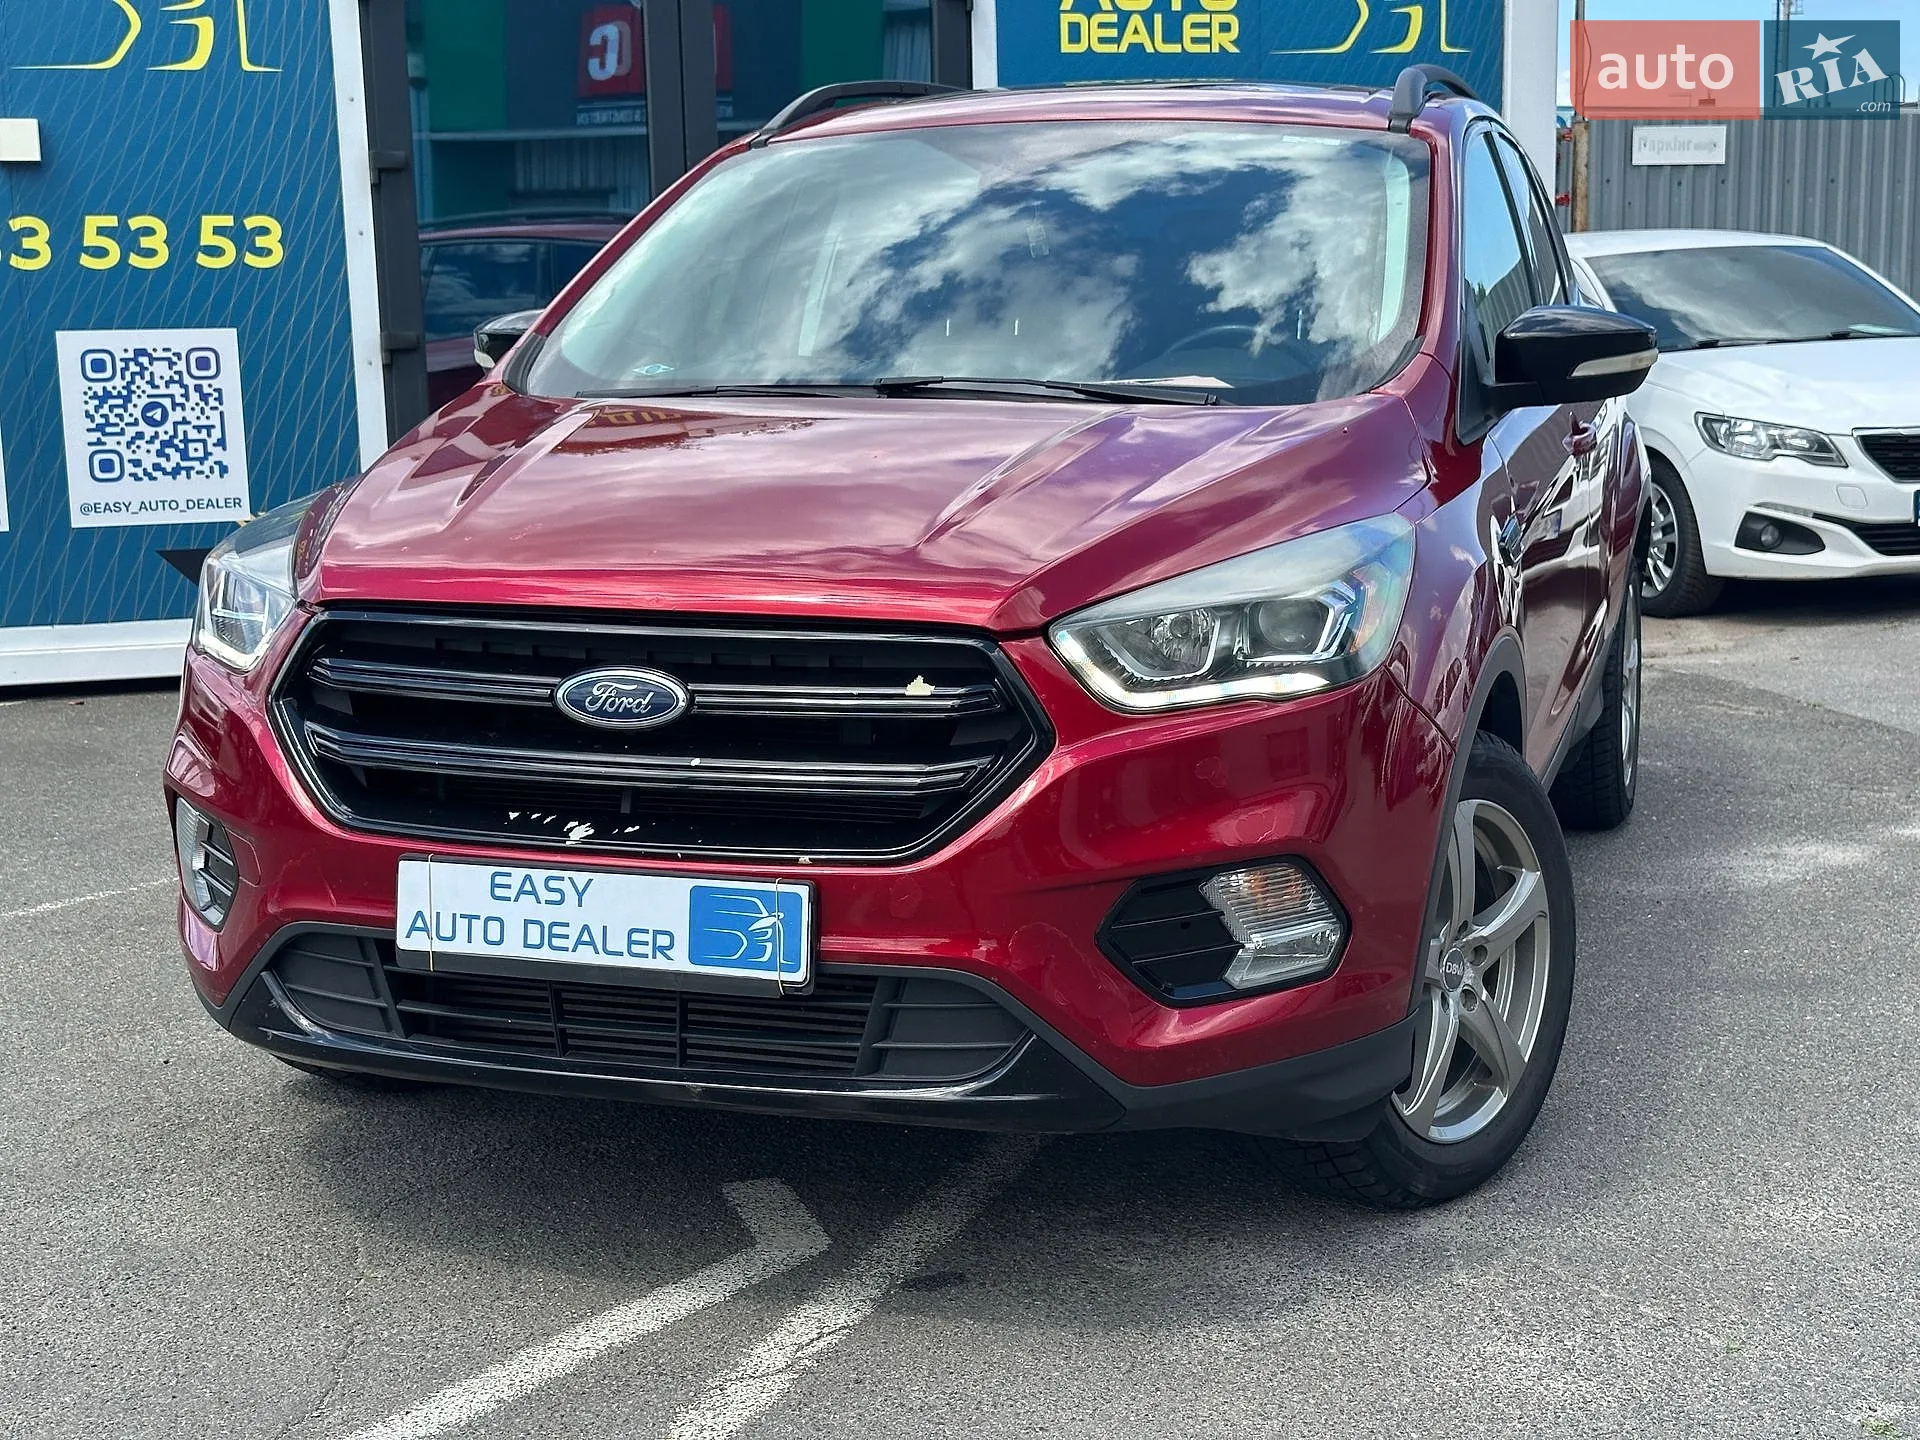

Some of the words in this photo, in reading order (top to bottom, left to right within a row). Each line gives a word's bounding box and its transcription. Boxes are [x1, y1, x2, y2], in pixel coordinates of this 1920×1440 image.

[1060, 13, 1240, 53] DEALER
[80, 215, 169, 270] 53
[196, 215, 284, 269] 53
[80, 497, 243, 516] @EASY_AUTO_DEALER
[585, 682, 655, 713] Ford
[490, 870, 594, 908] EASY
[405, 910, 506, 946] AUTO
[522, 919, 675, 961] DEALER
